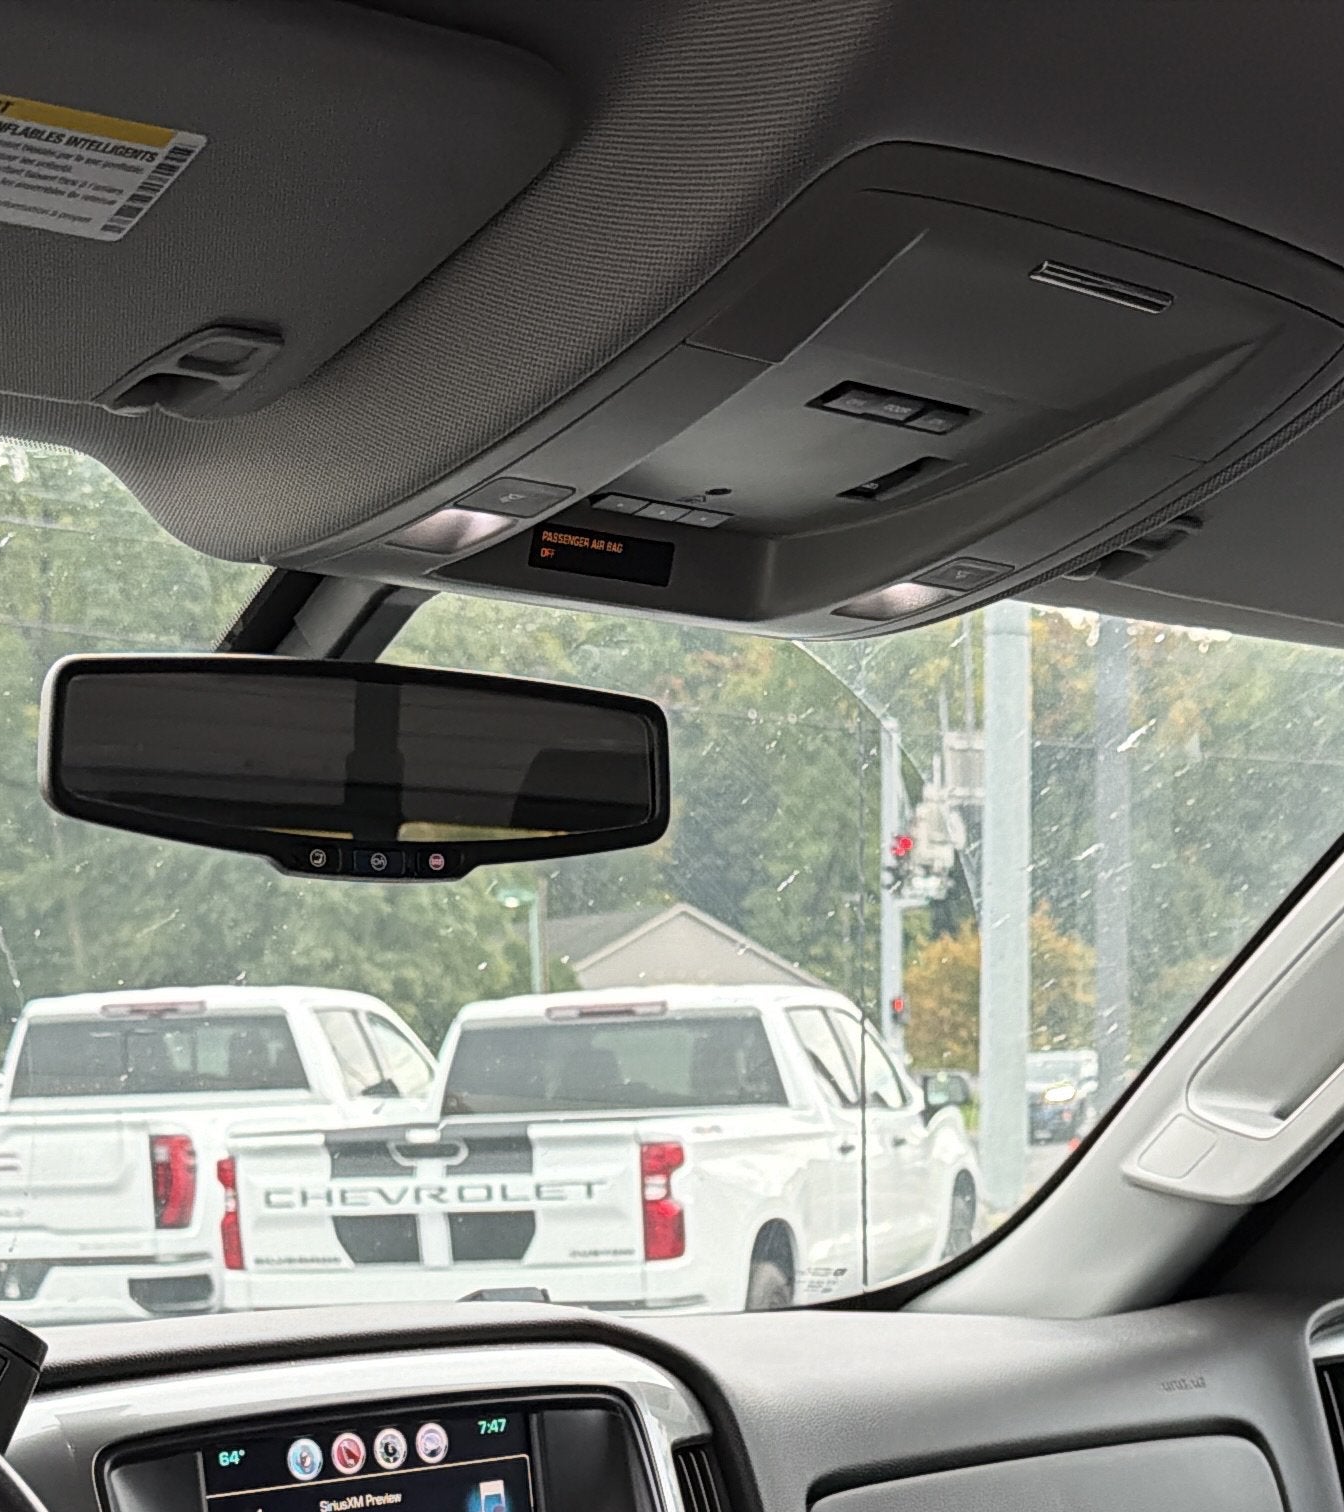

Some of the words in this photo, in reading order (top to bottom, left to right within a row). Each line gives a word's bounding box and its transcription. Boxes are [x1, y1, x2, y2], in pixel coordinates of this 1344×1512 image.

[65, 134, 159, 164] INTELLIGENTS
[541, 529, 590, 549] PASSENGER
[590, 538, 605, 551] AIR
[606, 542, 624, 554] BAG
[539, 547, 556, 559] OFF
[264, 1178, 607, 1209] CHEVROLET
[478, 1418, 508, 1435] 7:47
[365, 1490, 402, 1508] Preview
